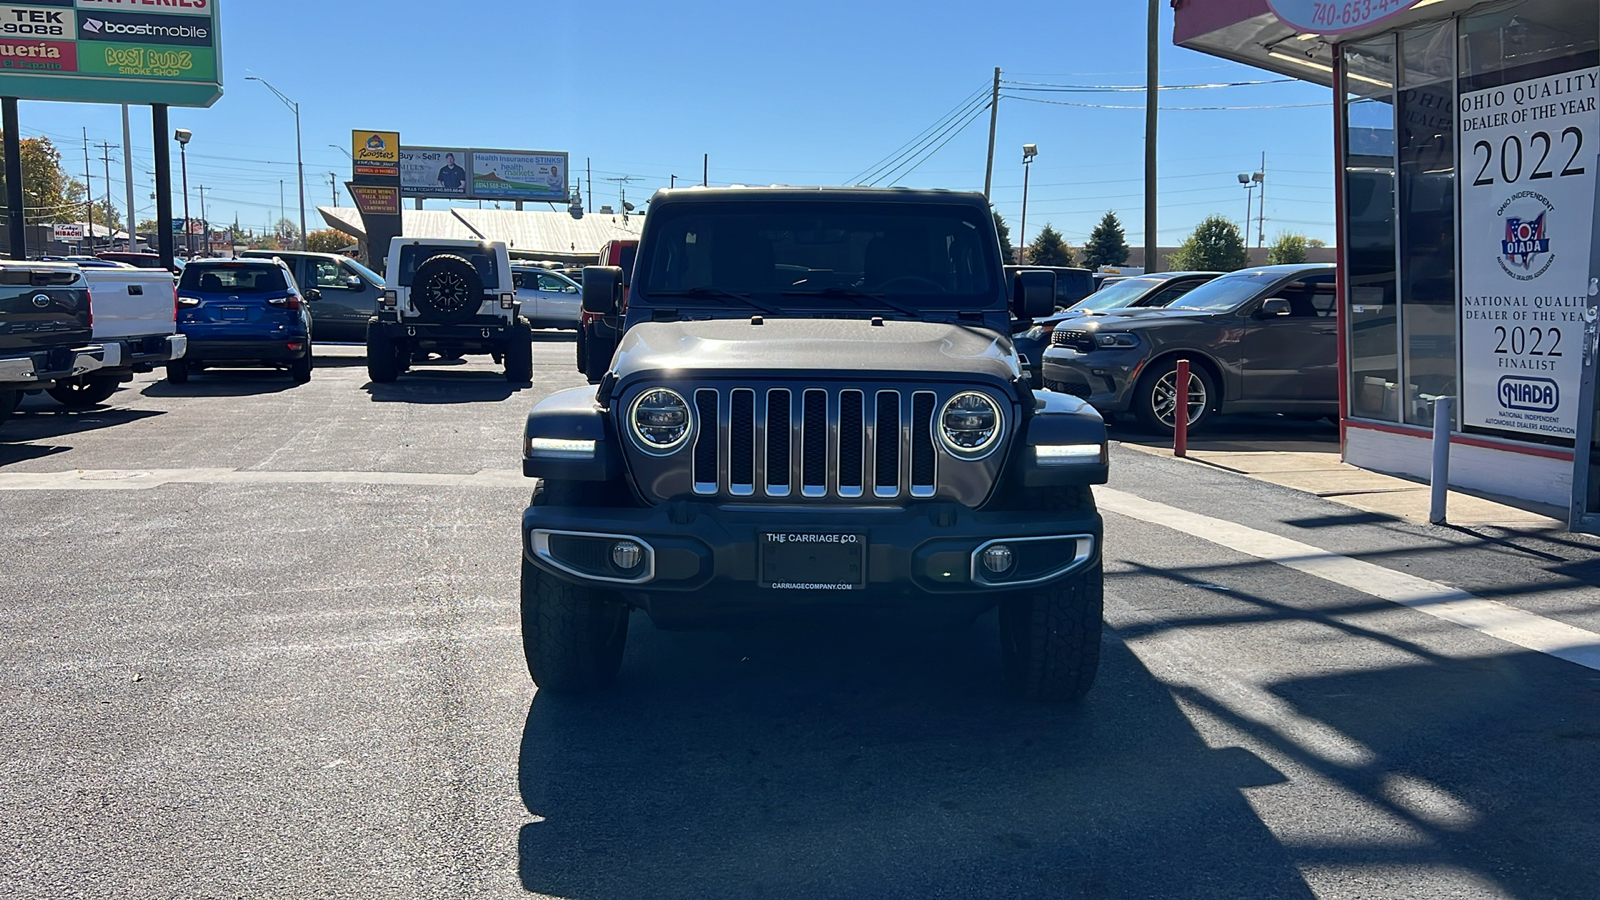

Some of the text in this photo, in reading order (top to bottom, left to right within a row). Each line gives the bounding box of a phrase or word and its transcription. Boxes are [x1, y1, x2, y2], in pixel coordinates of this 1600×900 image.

[11, 9, 64, 24] TEK
[1311, 0, 1399, 26] 740-653-4
[104, 21, 208, 38] boostmobile
[3, 59, 15, 68] El
[147, 49, 193, 70] BUDZ
[119, 66, 180, 76] SMOKE SHOP
[1461, 72, 1599, 112] OHIO QUALITY
[1463, 97, 1597, 132] DEALER OF THE YEAR
[358, 148, 395, 159] Roosters
[399, 152, 414, 161] Buy
[422, 152, 441, 161] Sell?
[500, 155, 534, 163] Insurance
[535, 156, 563, 164] STINKS!
[1472, 126, 1585, 187] 2022
[501, 163, 524, 171] health
[504, 169, 535, 177] markets
[1496, 190, 1555, 216] OHIO INDEPENDENT
[1507, 240, 1541, 254] OIADA
[1465, 296, 1586, 308] NATIONAL QUALIT
[1466, 310, 1585, 322] DEALER OF THE YEA
[1494, 325, 1562, 357] 2022
[1498, 357, 1556, 371] FINALIST
[1502, 382, 1553, 405] NIADA
[1498, 411, 1559, 423] NATIONAL INDEPENDENT
[1485, 418, 1575, 434] AUTOMOBILE DEALERS ASSOCIATION
[766, 533, 858, 543] THE CARRIAGE CO.
[771, 582, 853, 590] CARRIAGECOMPANY.COM
